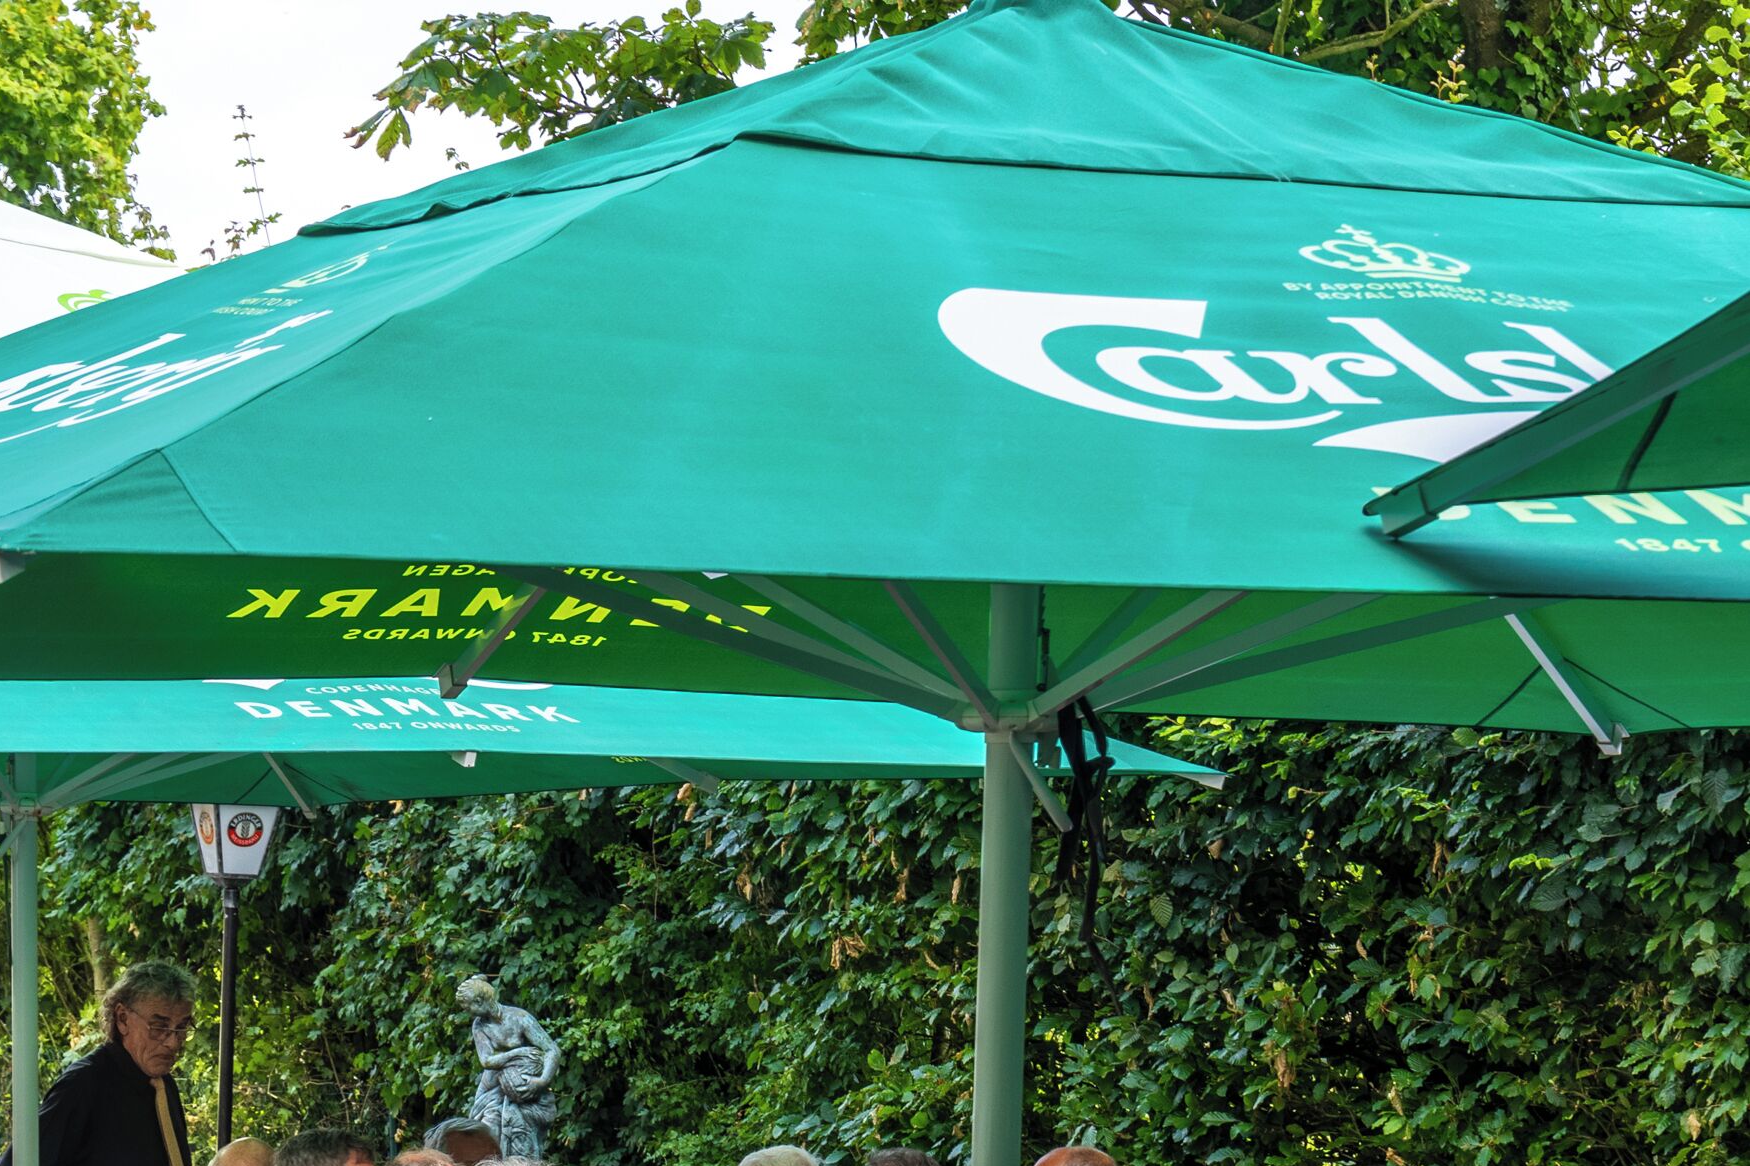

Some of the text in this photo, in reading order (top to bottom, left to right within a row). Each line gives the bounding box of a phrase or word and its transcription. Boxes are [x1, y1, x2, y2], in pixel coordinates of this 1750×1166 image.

[1282, 282, 1313, 291] BY
[1319, 281, 1488, 297] APPOINTMENT
[1314, 290, 1395, 300] ROYAL
[1397, 289, 1487, 304] DANISH
[1614, 538, 1723, 553] 1847
[234, 697, 581, 724] DENMARK
[352, 720, 521, 733] 1847 ONWARDS
[229, 812, 262, 829] ERDINGER
